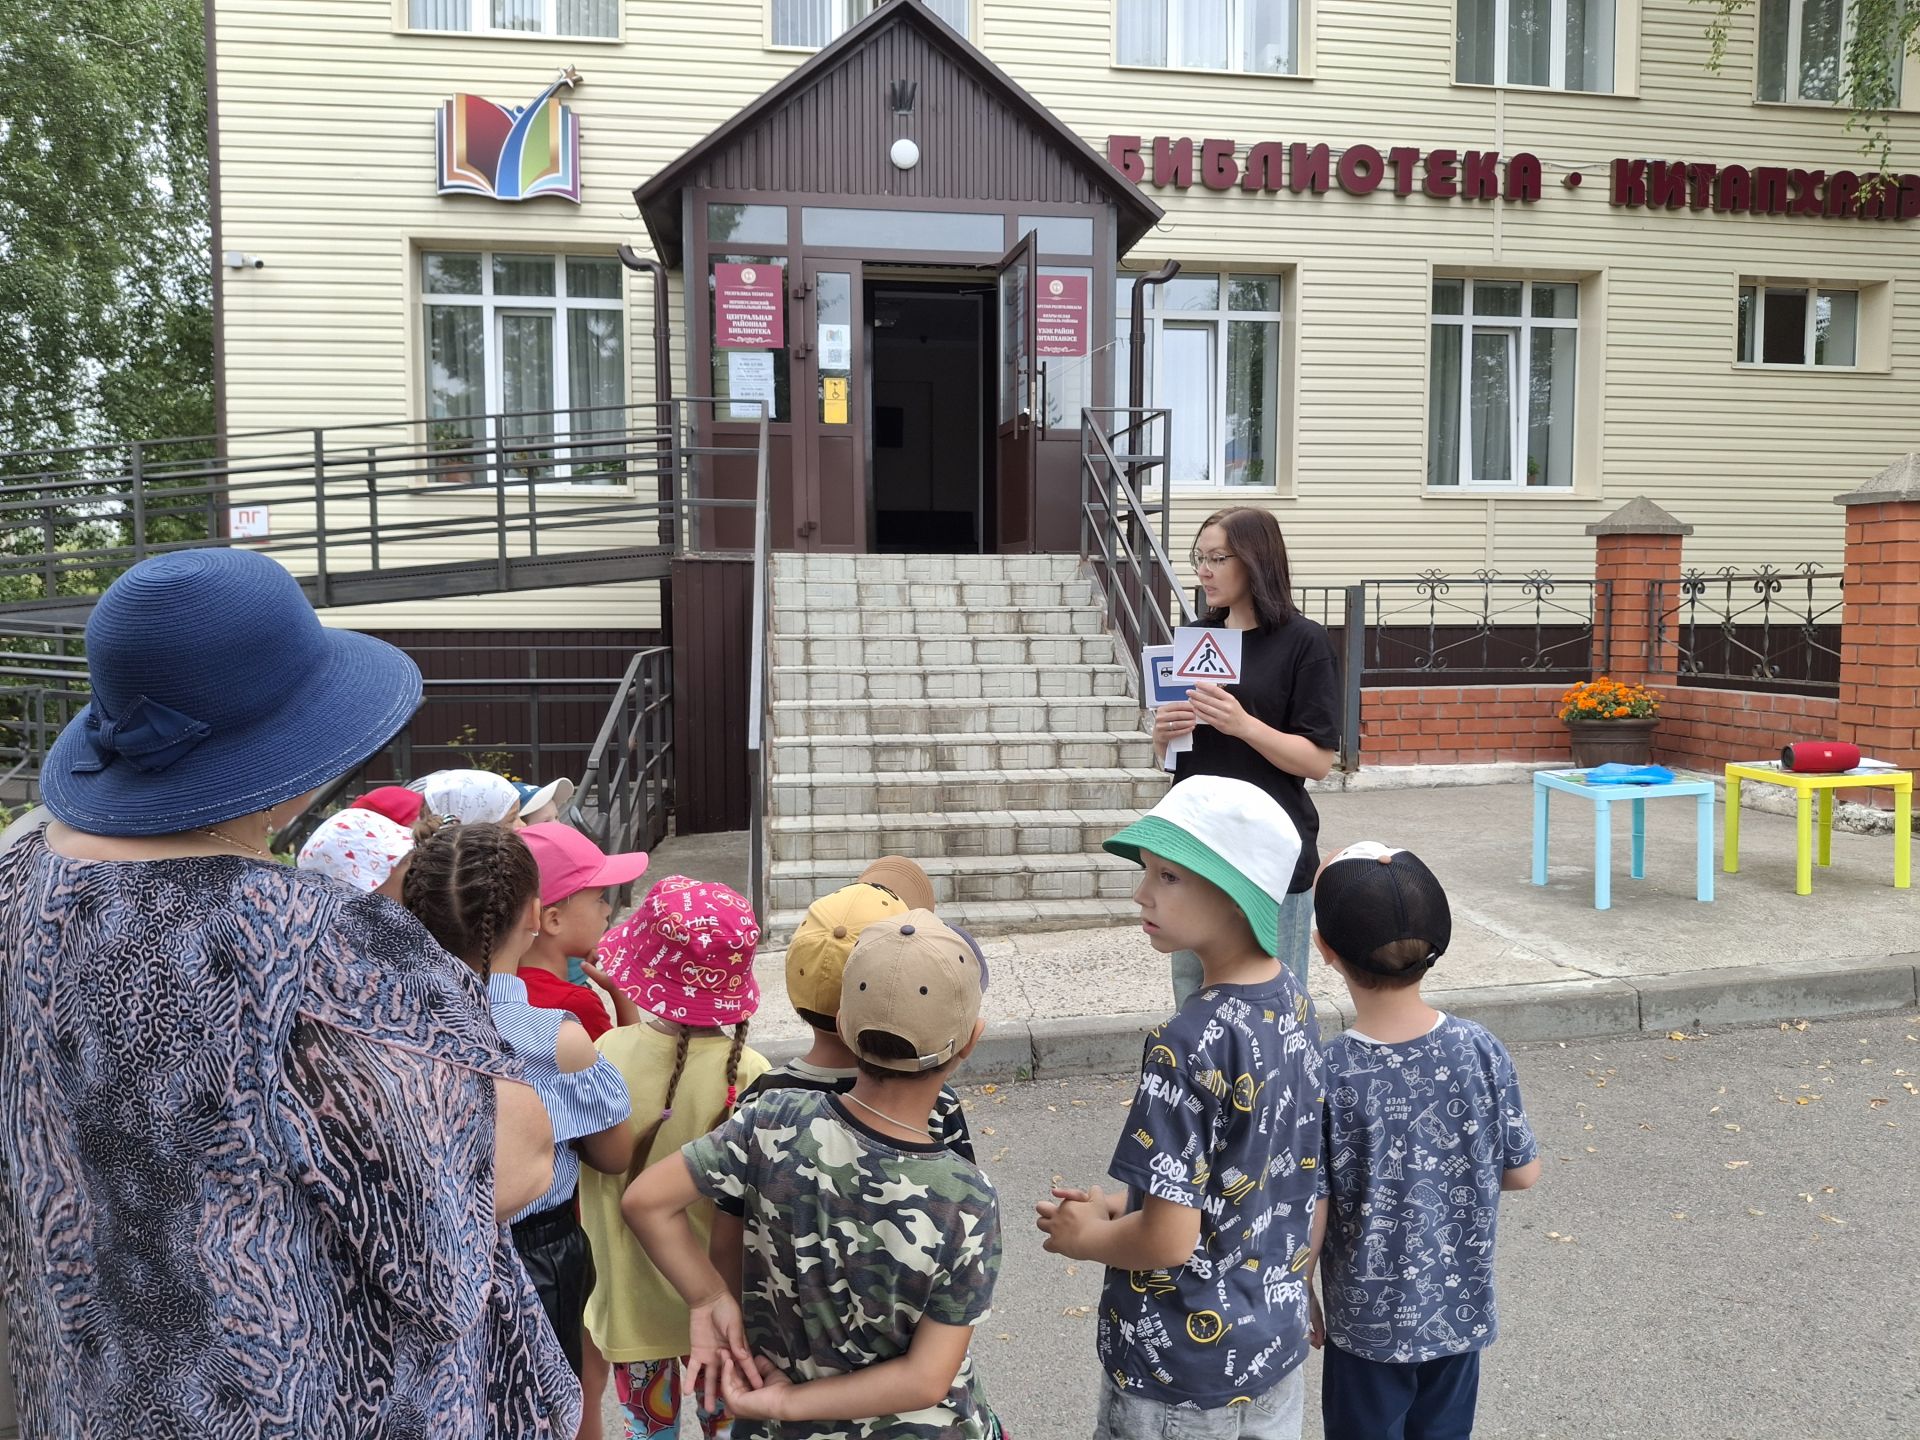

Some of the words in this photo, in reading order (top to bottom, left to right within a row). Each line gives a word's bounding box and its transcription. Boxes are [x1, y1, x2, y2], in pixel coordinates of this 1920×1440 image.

[1107, 134, 1542, 202] БИБЛИОТЕКА
[726, 313, 773, 321] ЦЕНТРАЛЬНАЯ
[239, 511, 260, 523] ПГ
[1140, 1072, 1183, 1108] YEAH
[1186, 1094, 1204, 1113] 1990
[1386, 1097, 1406, 1105] EVER
[1135, 1128, 1154, 1149] 1990
[1149, 1151, 1188, 1183] COOL
[1439, 1154, 1457, 1171] EVER
[1455, 1161, 1471, 1179] BEST
[1149, 1173, 1194, 1208] VIBES
[1374, 1192, 1398, 1206] FRIEND
[1378, 1185, 1398, 1197] BEST
[1374, 1201, 1393, 1212] EVER
[1218, 1214, 1241, 1233] ALWAYS
[1464, 1233, 1493, 1255] dogs
[1264, 1280, 1303, 1304] VIBES
[1155, 1367, 1174, 1384] 1990
